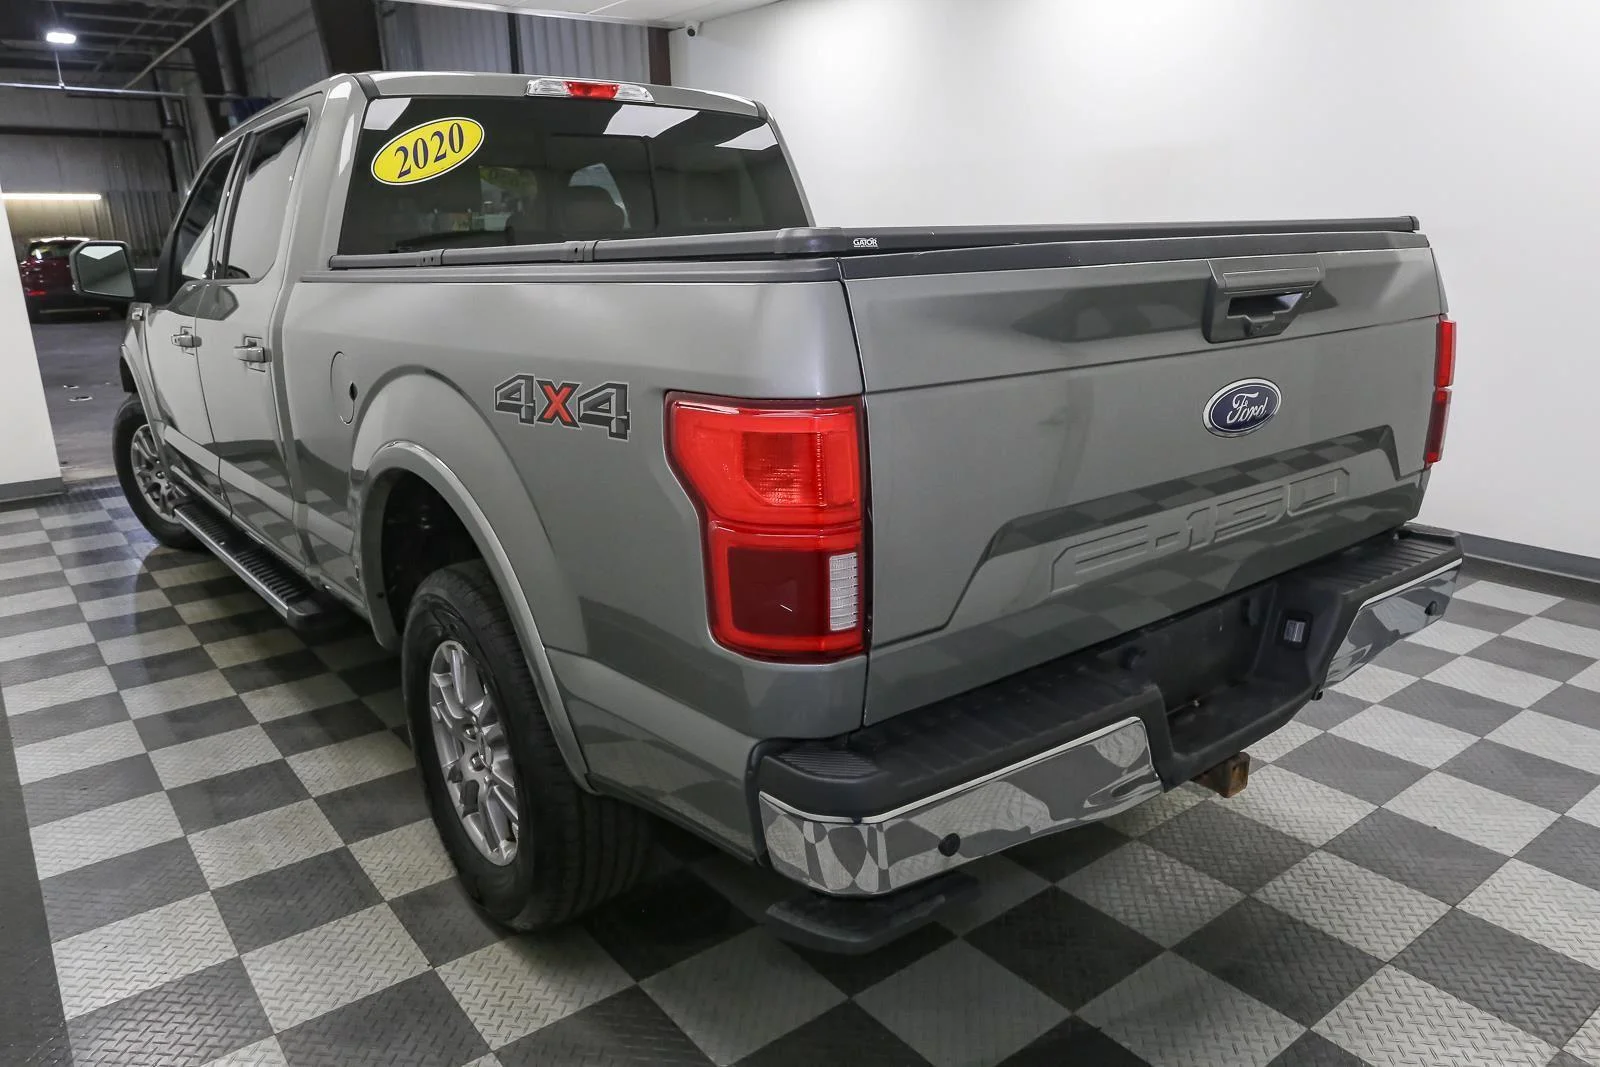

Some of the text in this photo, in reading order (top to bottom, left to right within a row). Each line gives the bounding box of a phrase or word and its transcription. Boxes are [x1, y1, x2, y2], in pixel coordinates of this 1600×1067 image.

[394, 122, 465, 178] 2020
[853, 238, 878, 246] GATOR
[1227, 392, 1268, 423] Ford
[1052, 467, 1351, 594] F-150
